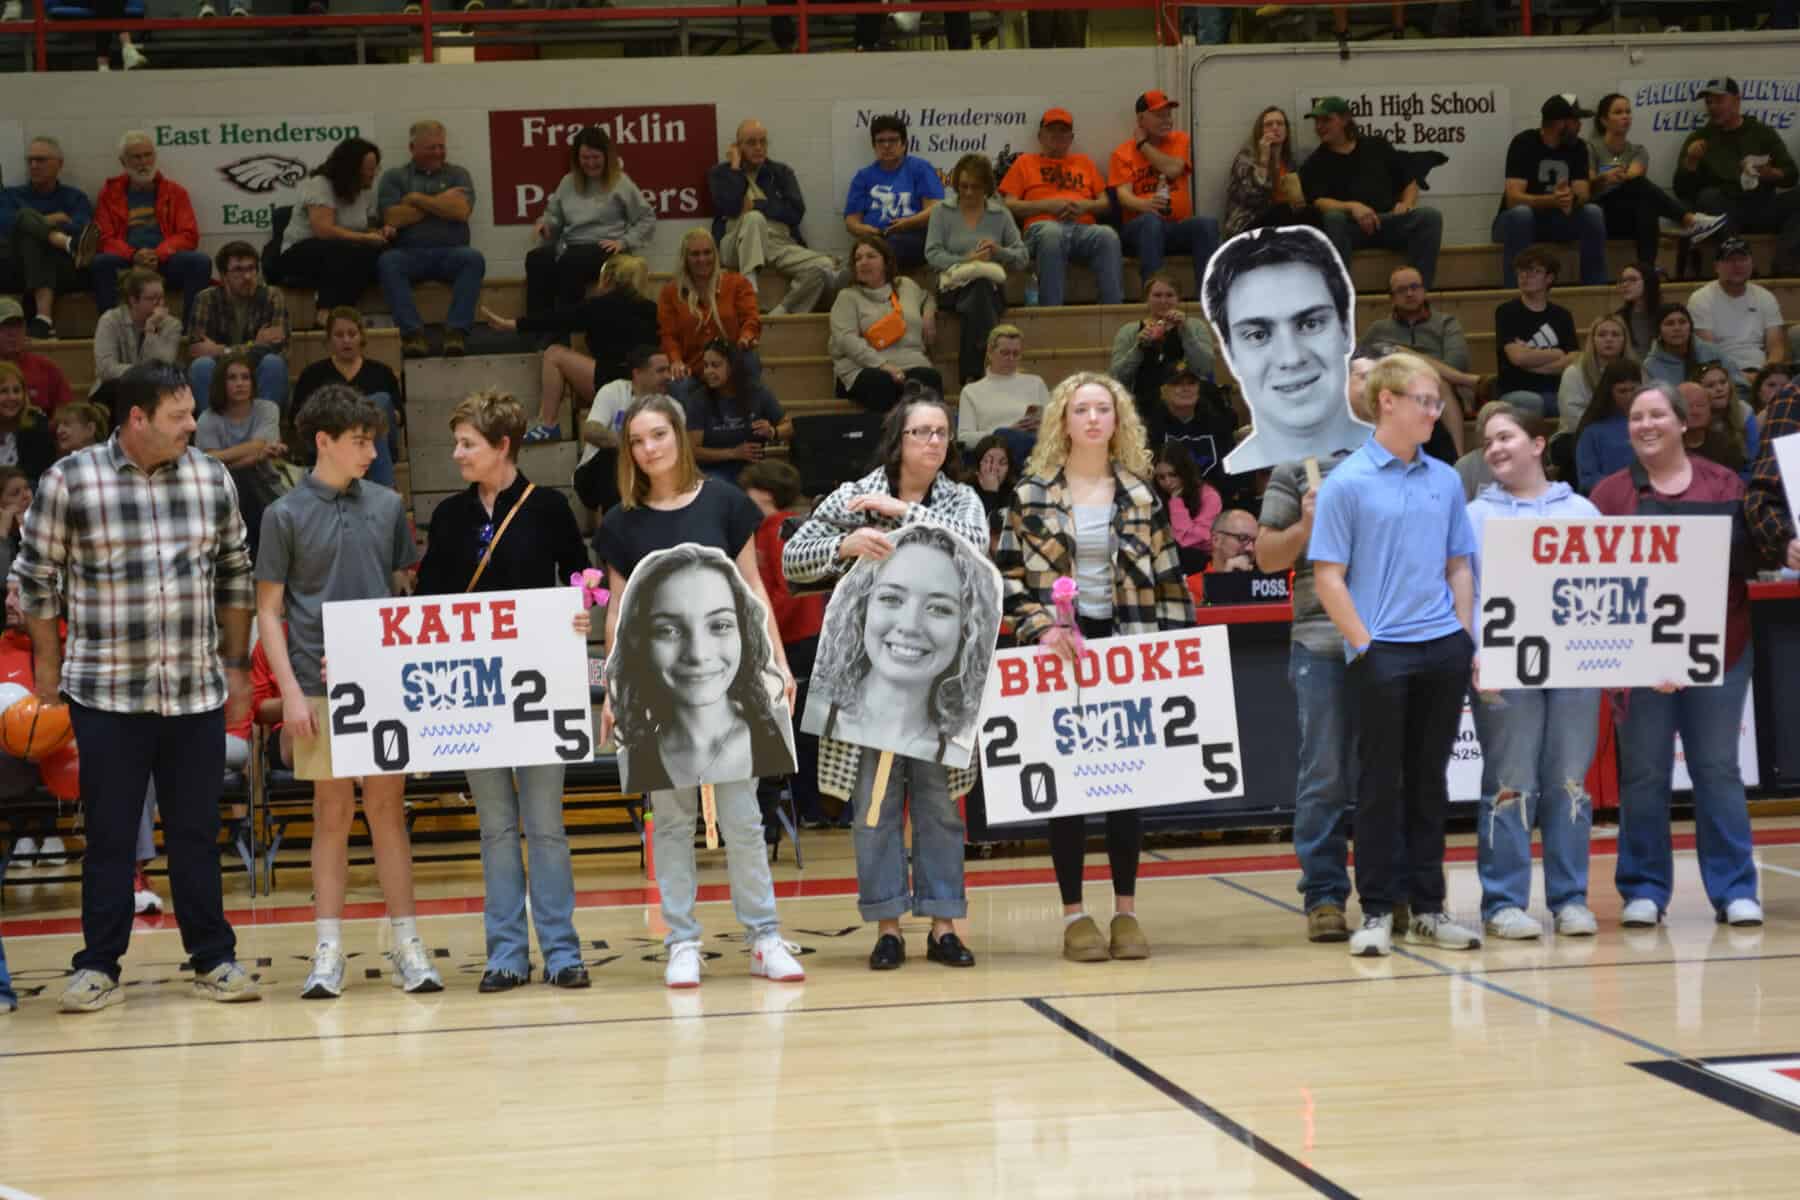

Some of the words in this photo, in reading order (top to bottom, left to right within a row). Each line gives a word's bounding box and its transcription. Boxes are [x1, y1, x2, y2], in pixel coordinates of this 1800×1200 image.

[920, 108, 1027, 127] Henderson
[1381, 93, 1424, 120] High
[1430, 90, 1496, 114] School
[155, 125, 212, 146] East
[220, 121, 361, 144] Henderson
[928, 134, 987, 152] School
[1414, 123, 1466, 144] Bears
[1532, 525, 1680, 564] GAVIN
[1252, 579, 1290, 597] POSS.
[1552, 576, 1648, 626] SWIM
[379, 600, 518, 647] KATE
[401, 656, 506, 712] SWIM
[997, 637, 1204, 697] BROOKE
[1053, 697, 1156, 756] SWIM
